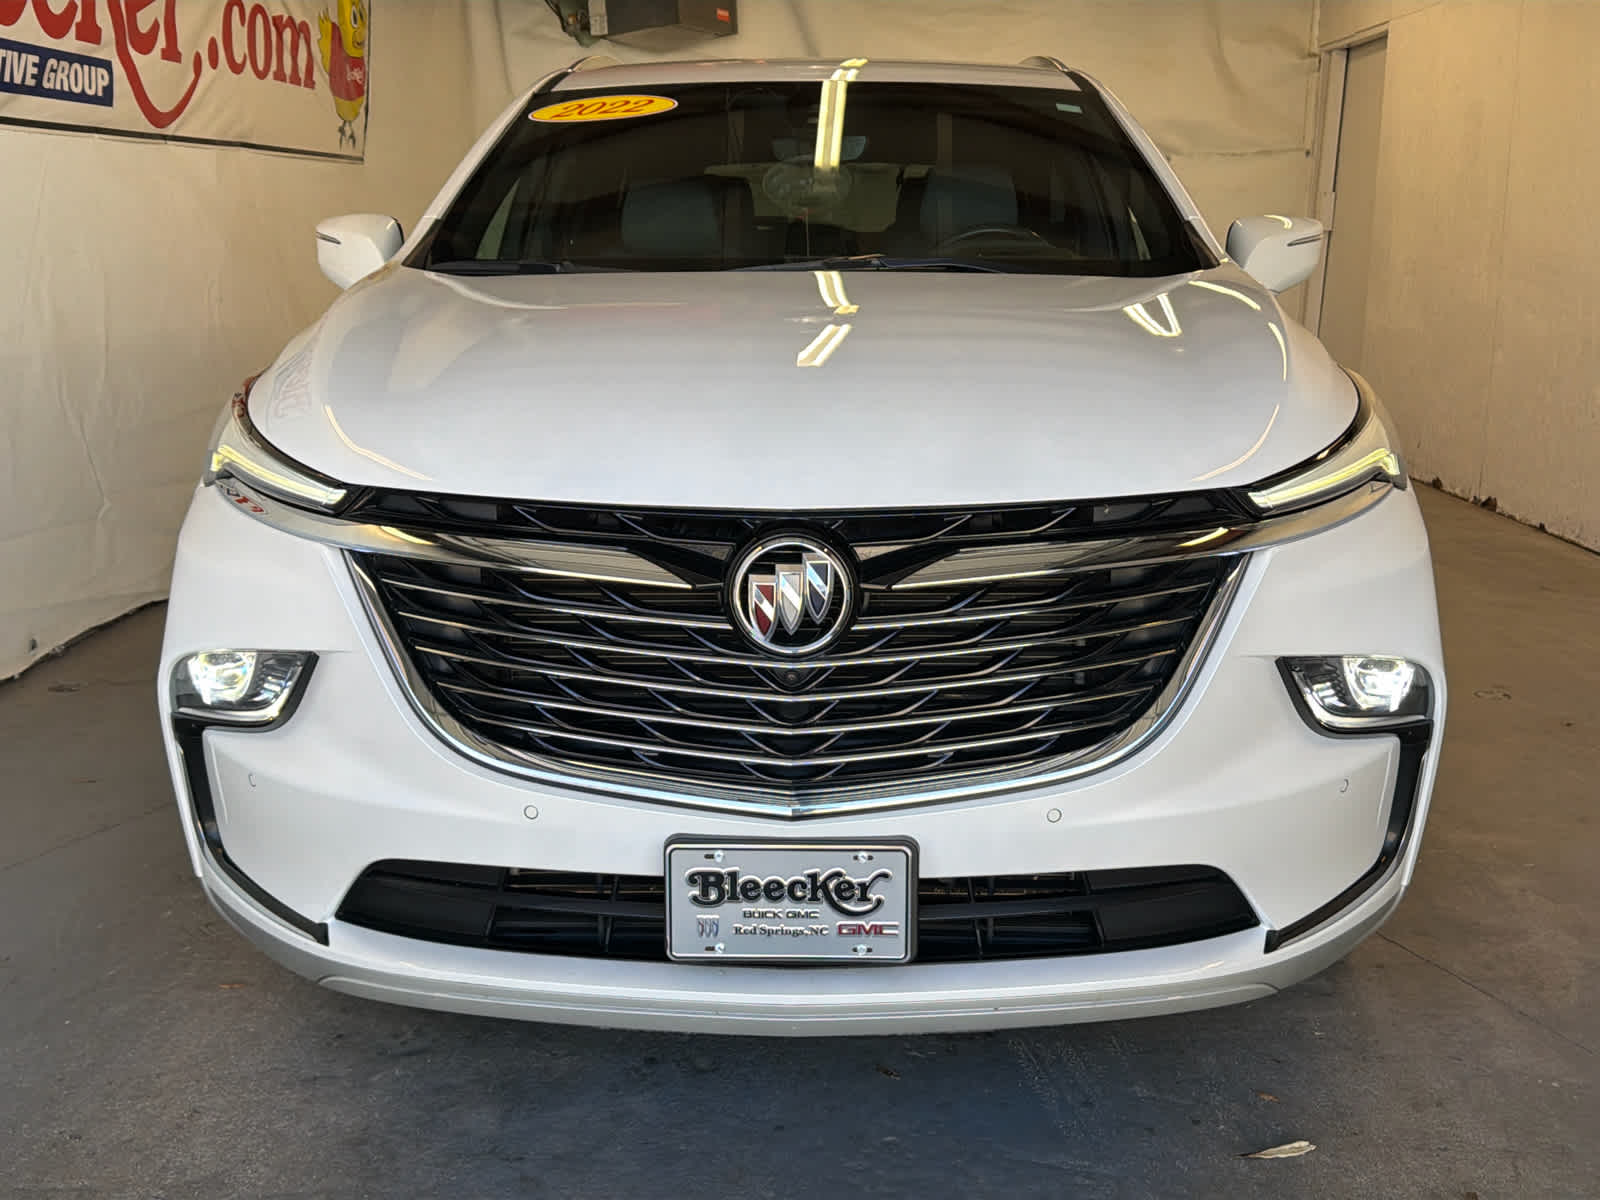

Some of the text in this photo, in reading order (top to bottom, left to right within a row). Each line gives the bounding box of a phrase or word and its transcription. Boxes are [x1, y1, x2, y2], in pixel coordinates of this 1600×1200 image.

[42, 57, 110, 97] GROUP
[551, 98, 655, 119] 2022
[743, 909, 820, 919] BUICK GMC
[734, 925, 757, 936] Red
[837, 922, 899, 937] GMC
